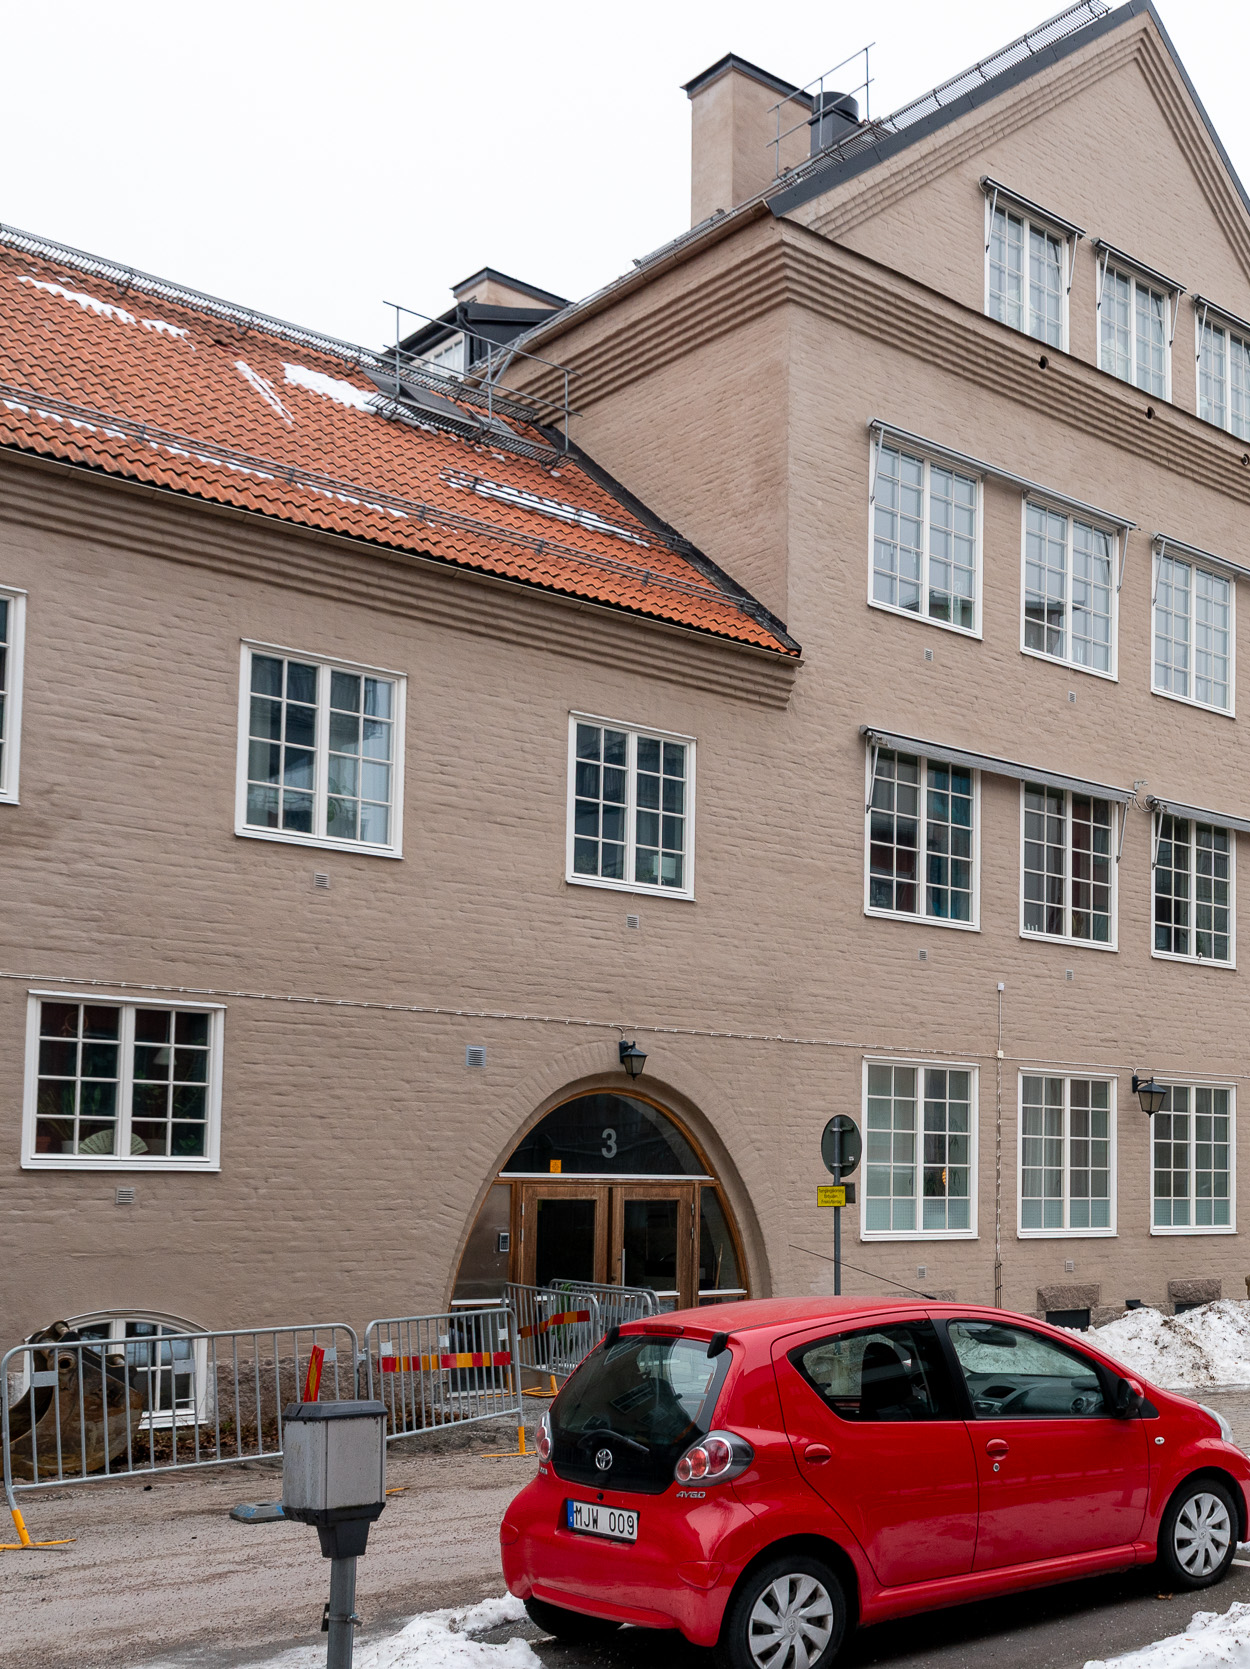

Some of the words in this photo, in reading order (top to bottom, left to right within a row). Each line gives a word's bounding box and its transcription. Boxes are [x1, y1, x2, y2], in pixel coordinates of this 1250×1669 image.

[601, 1128, 617, 1158] 3
[676, 1491, 706, 1499] AYGO
[574, 1505, 599, 1530] MJW
[609, 1511, 634, 1536] 009
